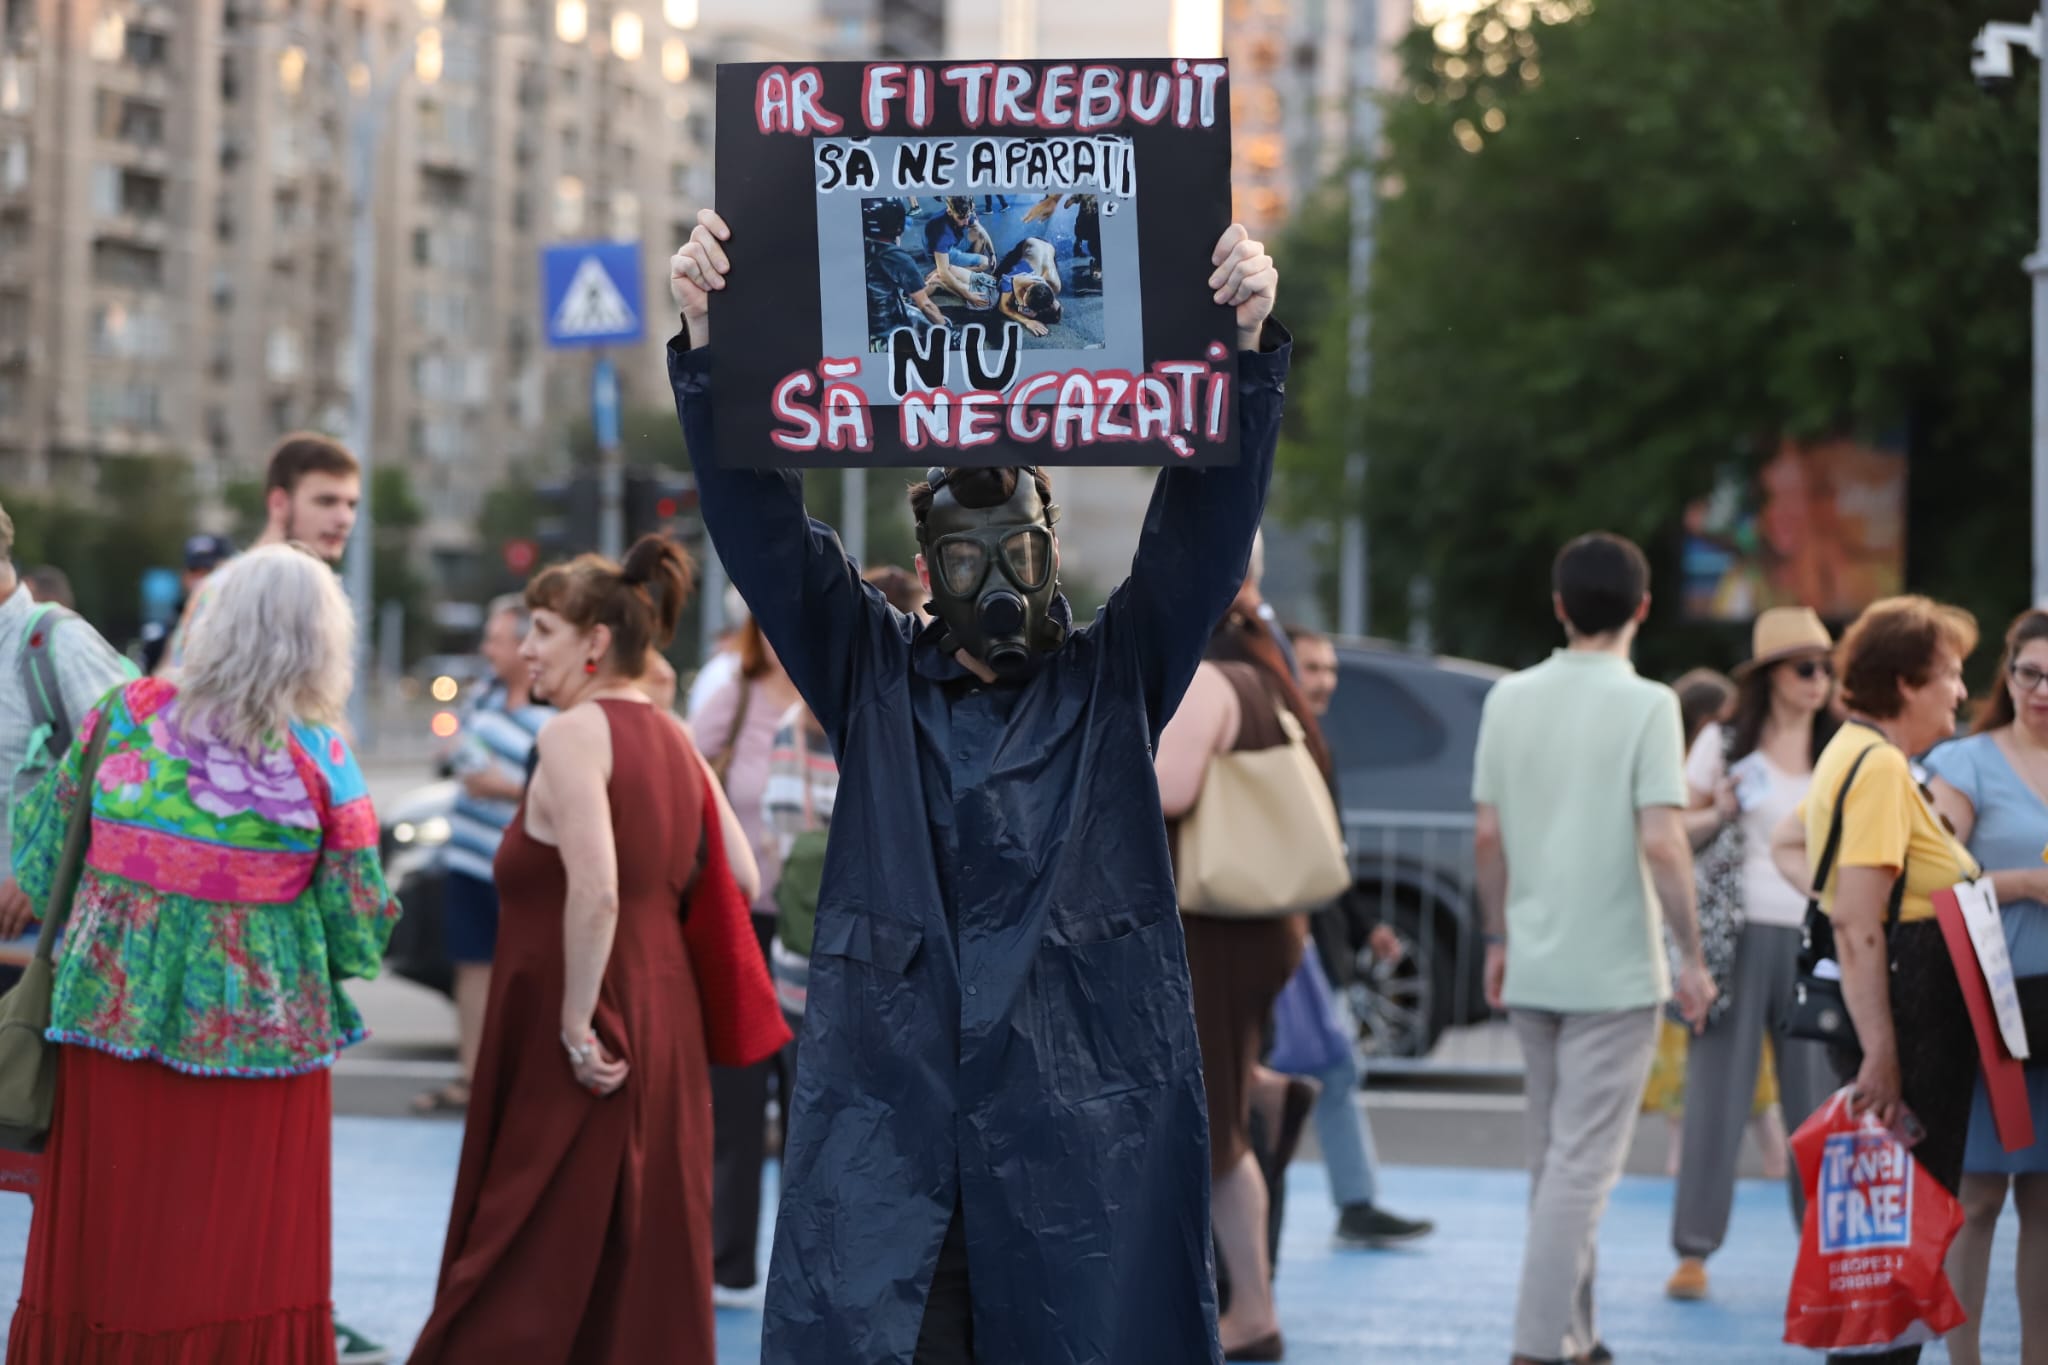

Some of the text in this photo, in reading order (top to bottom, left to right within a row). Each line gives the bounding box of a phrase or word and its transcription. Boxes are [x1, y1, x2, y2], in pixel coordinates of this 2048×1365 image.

[757, 65, 843, 134] AR
[863, 63, 934, 130] FI
[893, 141, 956, 189] NE
[889, 323, 1022, 401] NU
[899, 388, 1003, 452] NE
[1827, 1185, 1903, 1241] FREE
